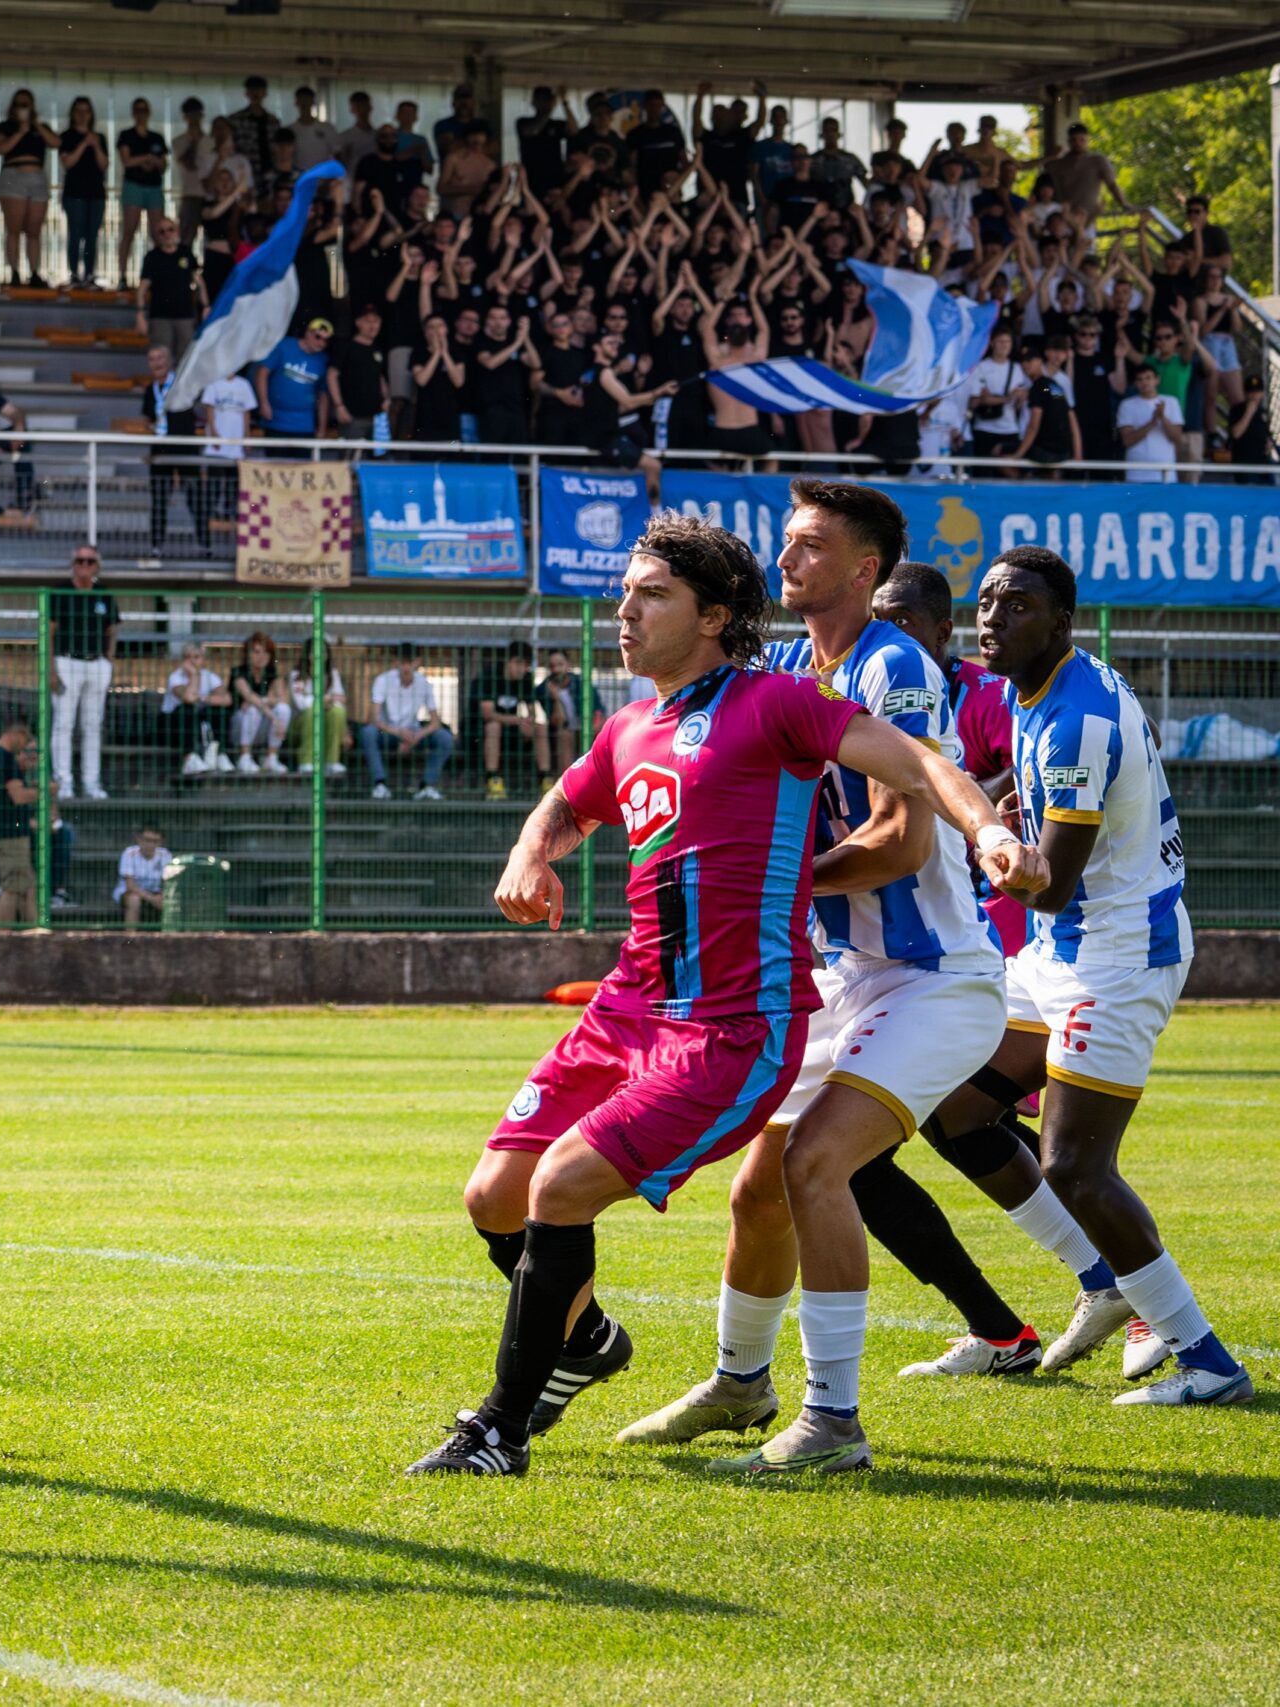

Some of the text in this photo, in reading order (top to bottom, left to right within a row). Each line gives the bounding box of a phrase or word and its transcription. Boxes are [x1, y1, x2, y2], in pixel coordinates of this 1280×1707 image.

[252, 468, 337, 490] MVRA
[883, 688, 937, 715] SAIP
[1043, 766, 1089, 785] SAIP
